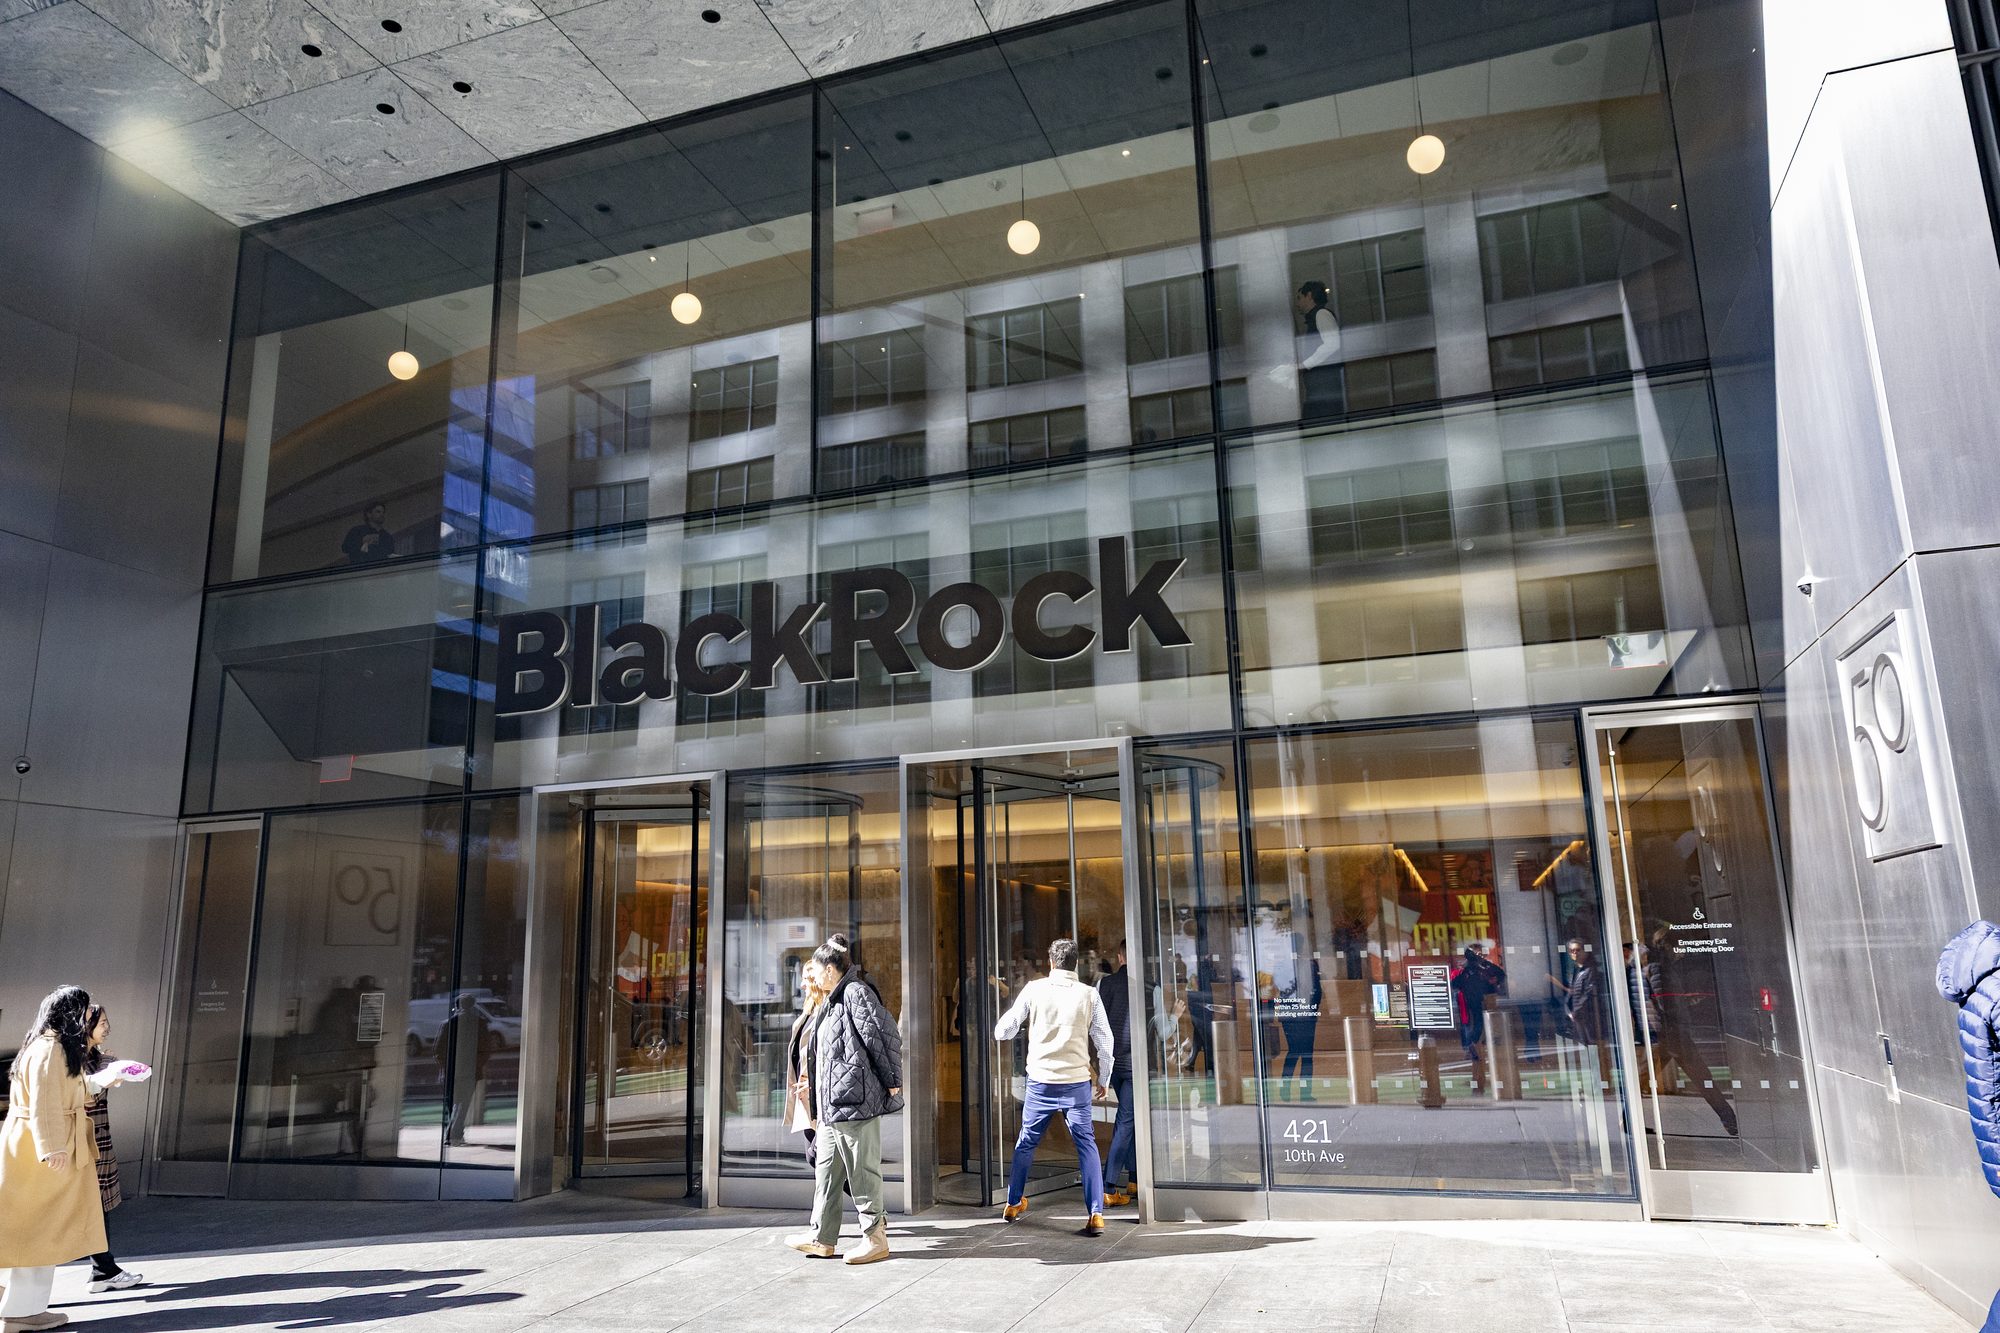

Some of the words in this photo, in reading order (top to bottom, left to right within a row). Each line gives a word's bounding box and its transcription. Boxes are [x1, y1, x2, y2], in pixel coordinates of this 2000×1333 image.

[496, 536, 1194, 716] BlackRock
[1851, 652, 1911, 832] 50
[1283, 1119, 1332, 1144] 421
[1284, 1149, 1316, 1162] 10th
[1319, 1149, 1344, 1163] Ave
